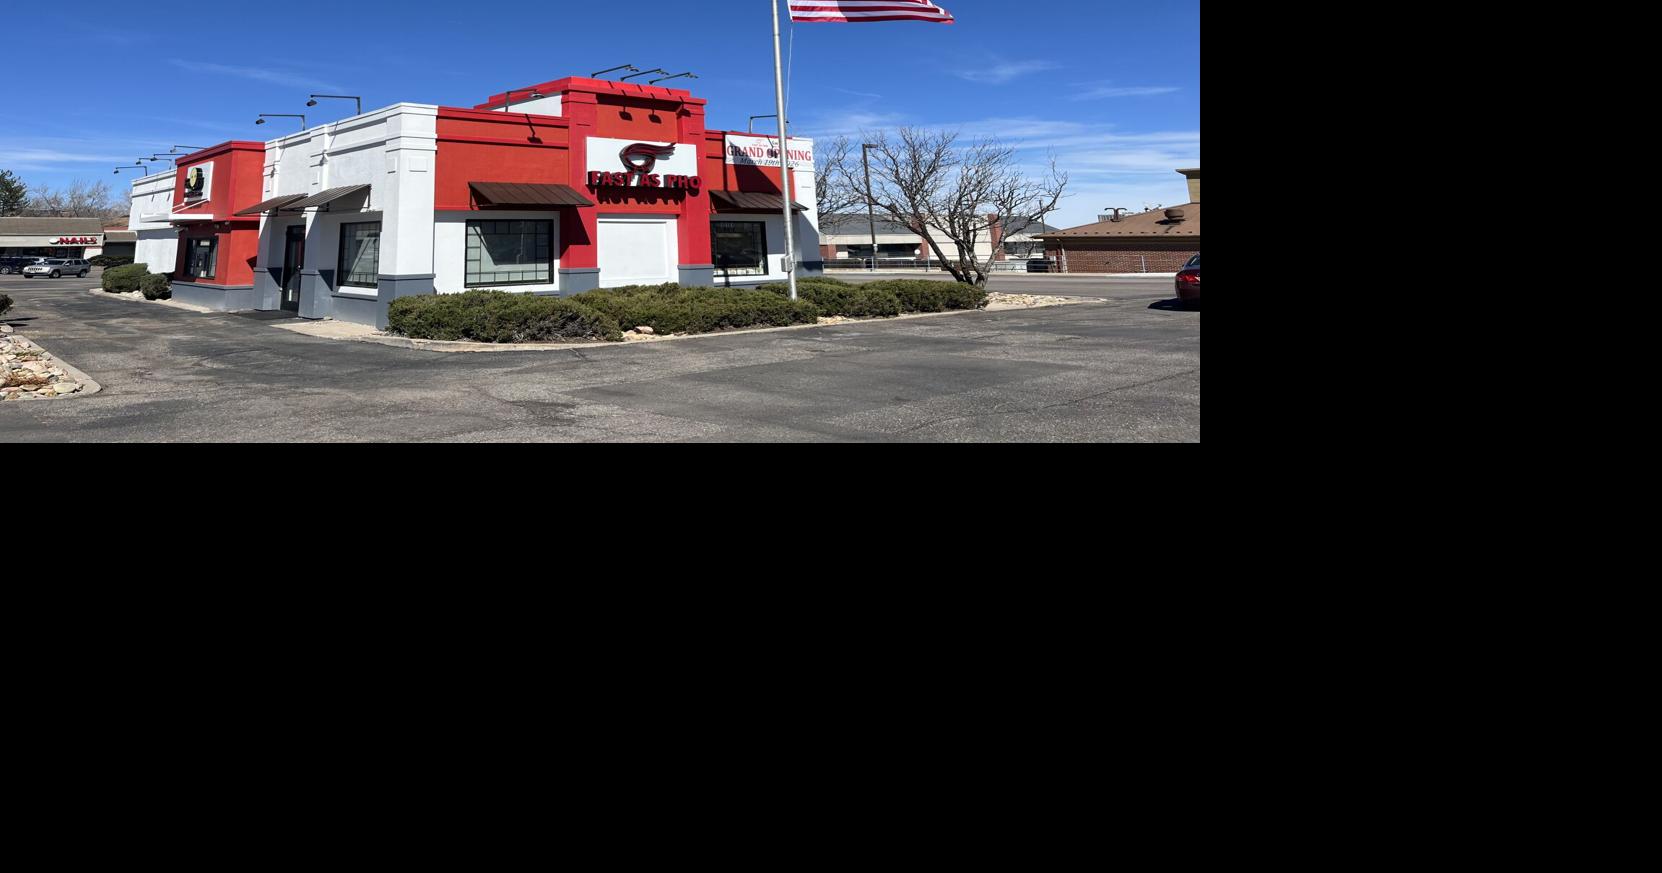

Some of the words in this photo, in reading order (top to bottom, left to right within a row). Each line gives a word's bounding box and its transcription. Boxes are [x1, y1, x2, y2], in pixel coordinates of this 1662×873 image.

[727, 145, 764, 159] GRAND
[766, 147, 812, 161] OPNING
[740, 157, 763, 165] March
[590, 170, 634, 187] FAST
[641, 173, 662, 188] AS
[666, 175, 703, 189] PHO
[59, 236, 98, 245] NAILS
